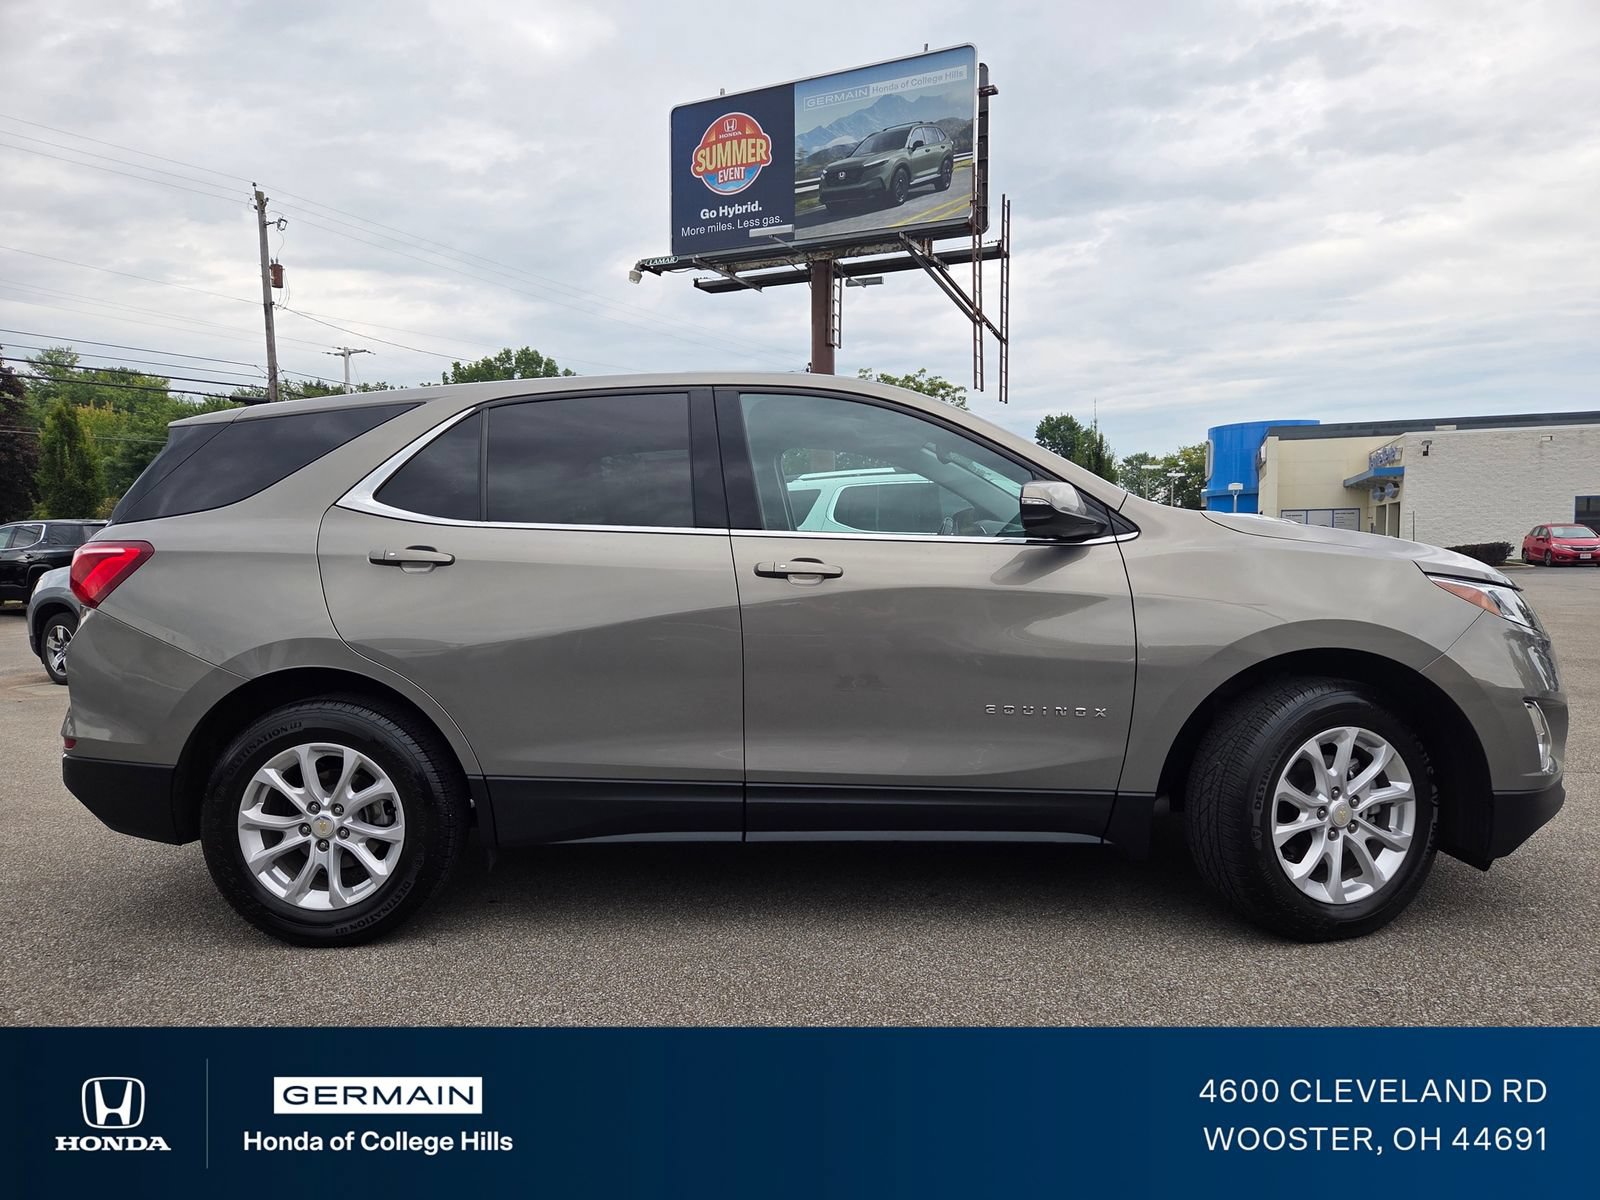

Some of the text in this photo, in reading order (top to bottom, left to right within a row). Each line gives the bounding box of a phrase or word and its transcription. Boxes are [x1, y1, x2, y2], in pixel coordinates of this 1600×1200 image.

[807, 70, 964, 108] GERMAIN Honda of College Hills
[719, 131, 742, 139] HONDA
[696, 138, 768, 172] SUMMER
[718, 166, 746, 183] EVENT
[700, 200, 763, 219] Go Hybrid.
[681, 215, 783, 237] More miles. Less gas.
[649, 256, 676, 266] LAMAR
[985, 704, 1107, 718] EQUINOX
